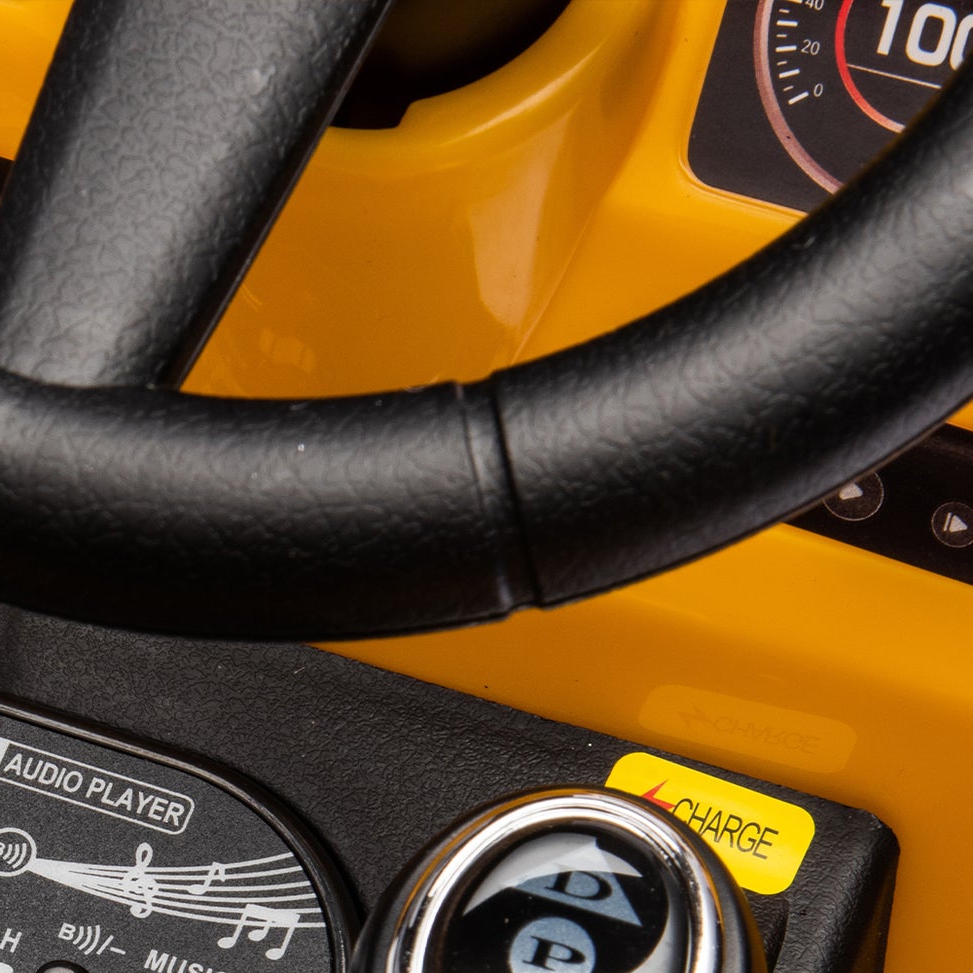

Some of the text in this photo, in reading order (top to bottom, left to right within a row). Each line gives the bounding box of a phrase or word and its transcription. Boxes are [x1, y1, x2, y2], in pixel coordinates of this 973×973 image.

[801, 39, 821, 56] 20
[813, 83, 824, 98] 0
[3, 753, 84, 793] AUDIO
[85, 777, 185, 827] PLAYER
[673, 798, 780, 861] CHARGE
[544, 863, 613, 902] D
[522, 935, 586, 972] P
